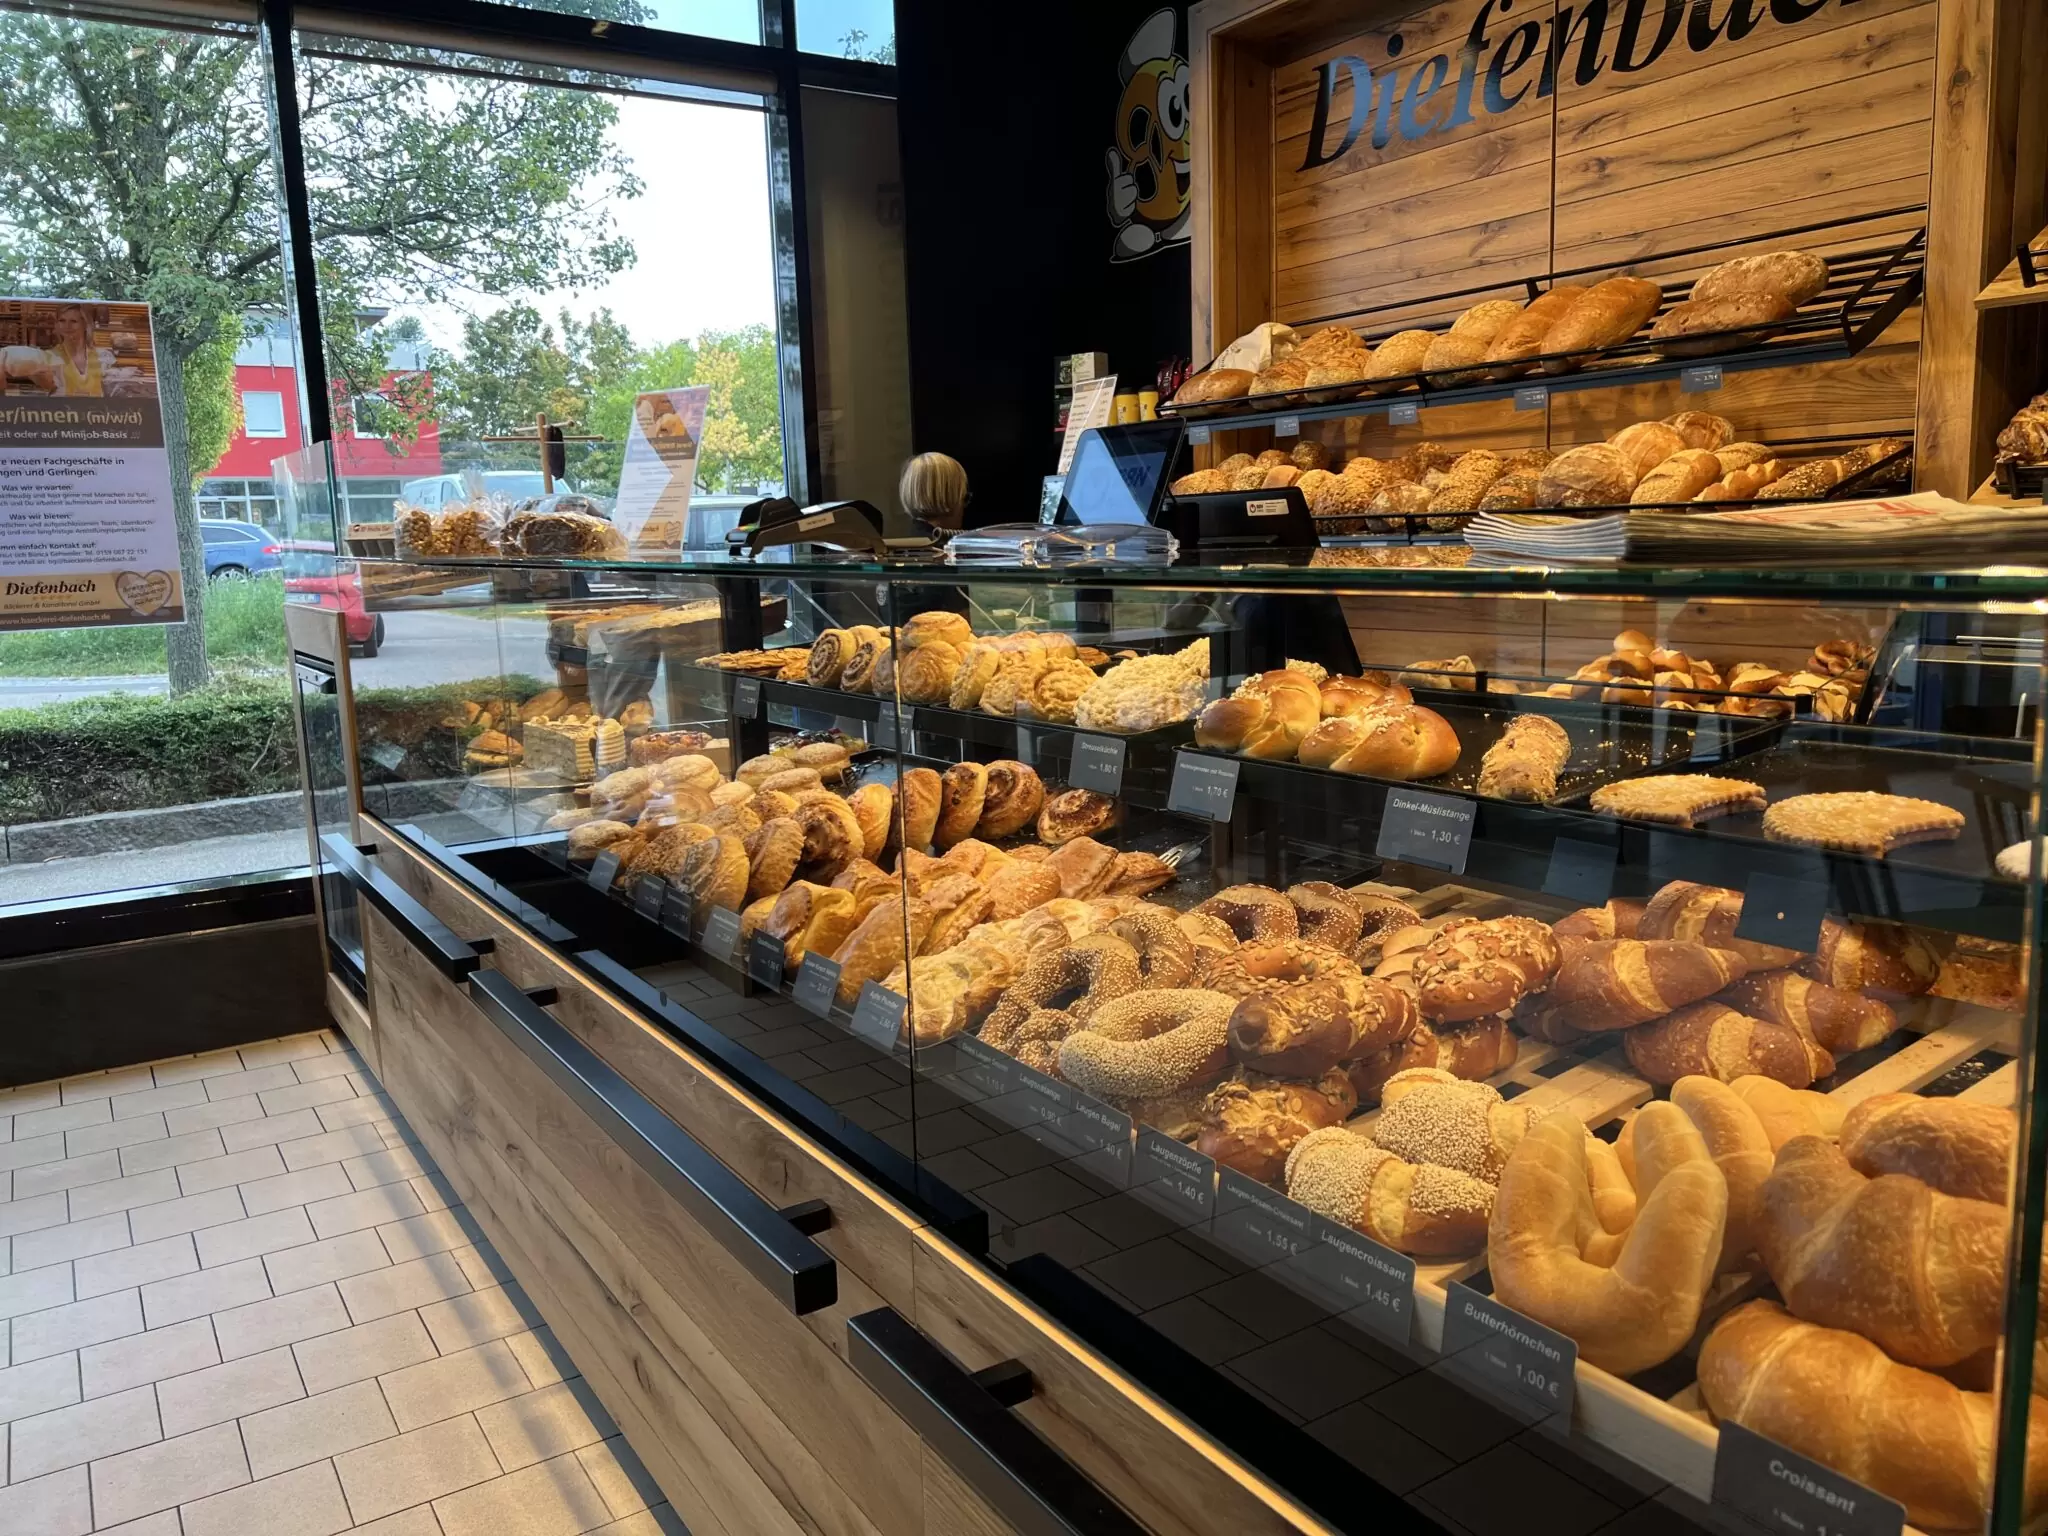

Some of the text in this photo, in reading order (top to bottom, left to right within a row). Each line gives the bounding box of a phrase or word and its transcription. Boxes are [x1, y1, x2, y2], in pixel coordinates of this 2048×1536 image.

[1297, 0, 1862, 173] Diefenba
[86, 410, 143, 425] (m/w/d)
[14, 430, 39, 439] oder
[41, 430, 58, 439] auf
[61, 430, 128, 441] Minijob-Basis
[25, 468, 45, 476] und
[44, 457, 113, 467] Fachgeschäfte
[115, 457, 124, 465] in
[6, 579, 96, 596] Diefenbach
[1207, 785, 1222, 797] 1,70
[1223, 788, 1229, 798] €
[1392, 798, 1471, 822] Dinkel-Müslistange
[1431, 829, 1452, 843] 1,30
[1453, 834, 1461, 845] €
[1076, 1100, 1122, 1133] Laugen Bagel
[1100, 1138, 1123, 1160] 1,40 €
[1150, 1139, 1202, 1175] Laugenzöpfle
[1177, 1181, 1196, 1201] 1,40
[1197, 1191, 1205, 1205] €
[1227, 1183, 1305, 1231] Laugen-Sesam-Croissant
[1266, 1229, 1298, 1256] 1,55 €
[1321, 1228, 1407, 1283] Laugencroissant
[1365, 1282, 1401, 1313] 1,45 €
[1464, 1302, 1561, 1363] Butterhörnchen
[1516, 1363, 1560, 1399] 1,00 €
[1769, 1459, 1857, 1516] Croissant
